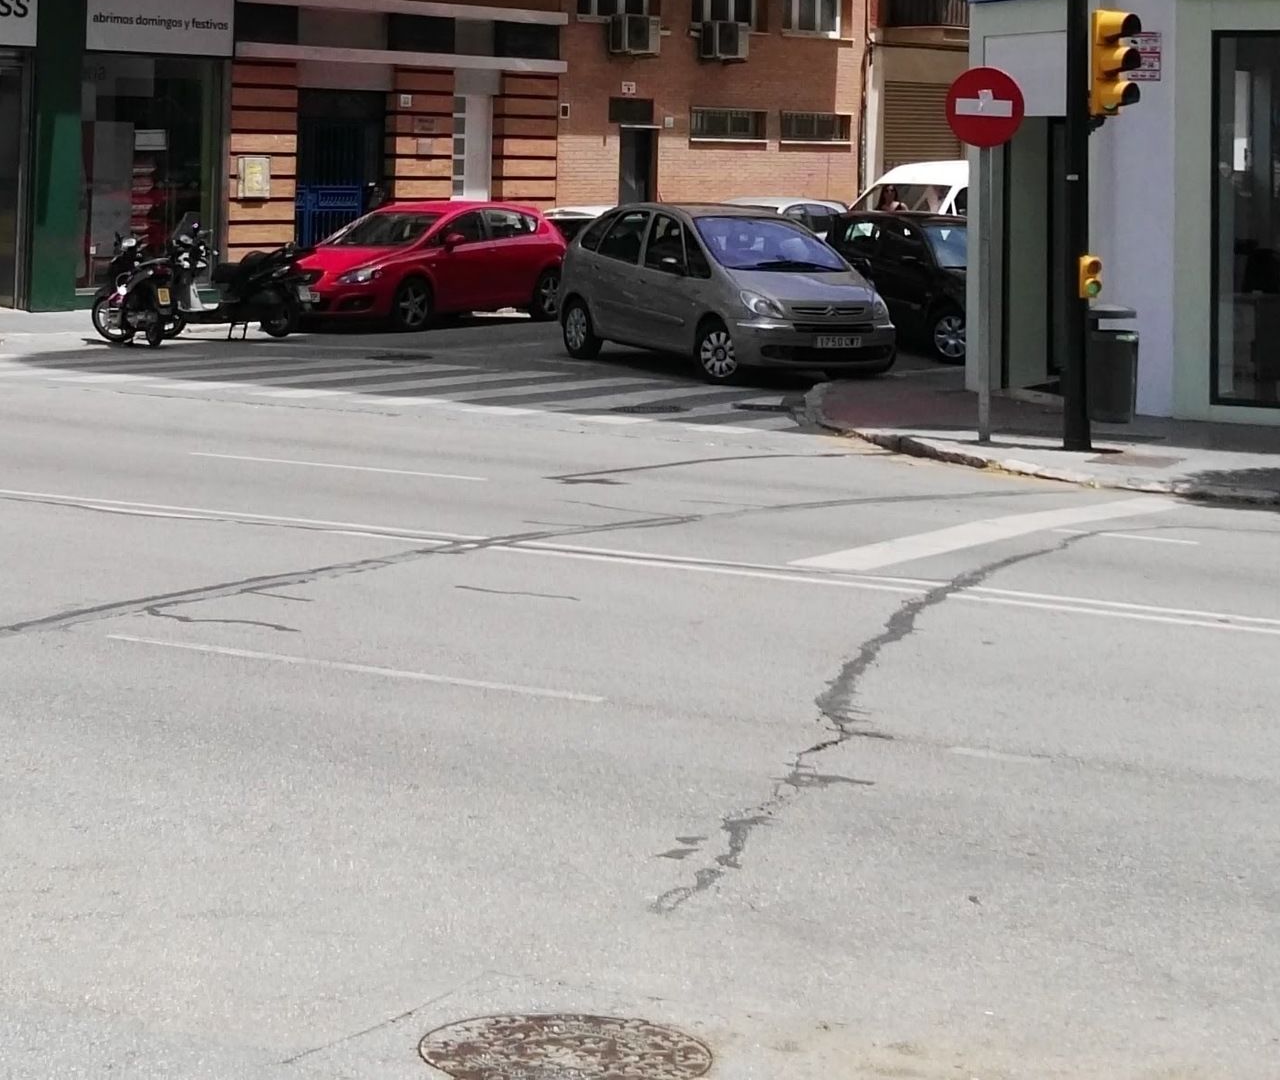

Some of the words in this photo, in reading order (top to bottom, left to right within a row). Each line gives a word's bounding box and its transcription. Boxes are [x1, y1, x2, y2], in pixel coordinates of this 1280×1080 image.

[93, 12, 134, 25] abrimos
[135, 15, 183, 30] domingos
[182, 20, 190, 31] y
[192, 18, 229, 31] festivos
